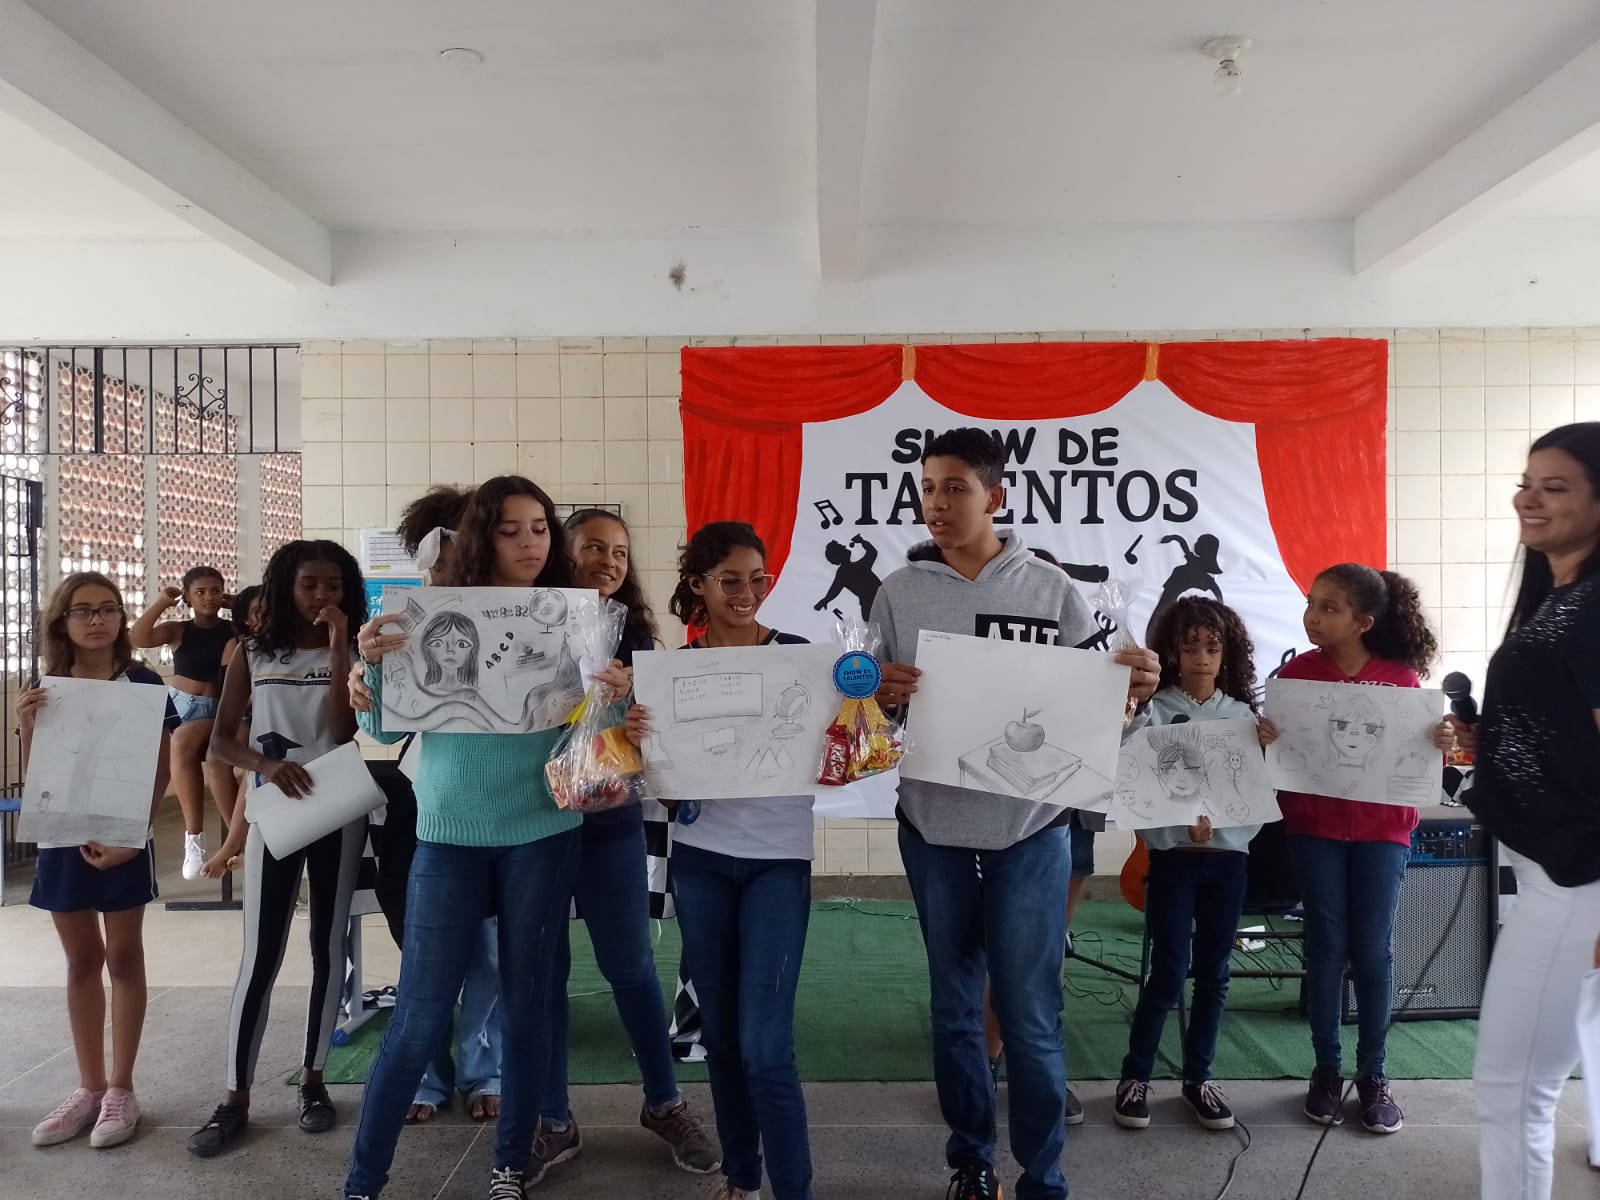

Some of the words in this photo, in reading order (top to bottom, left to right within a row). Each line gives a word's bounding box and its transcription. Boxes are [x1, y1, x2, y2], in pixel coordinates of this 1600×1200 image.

[892, 427, 1036, 465] SW
[1059, 428, 1119, 466] DE
[845, 469, 1198, 525] TAENTOS
